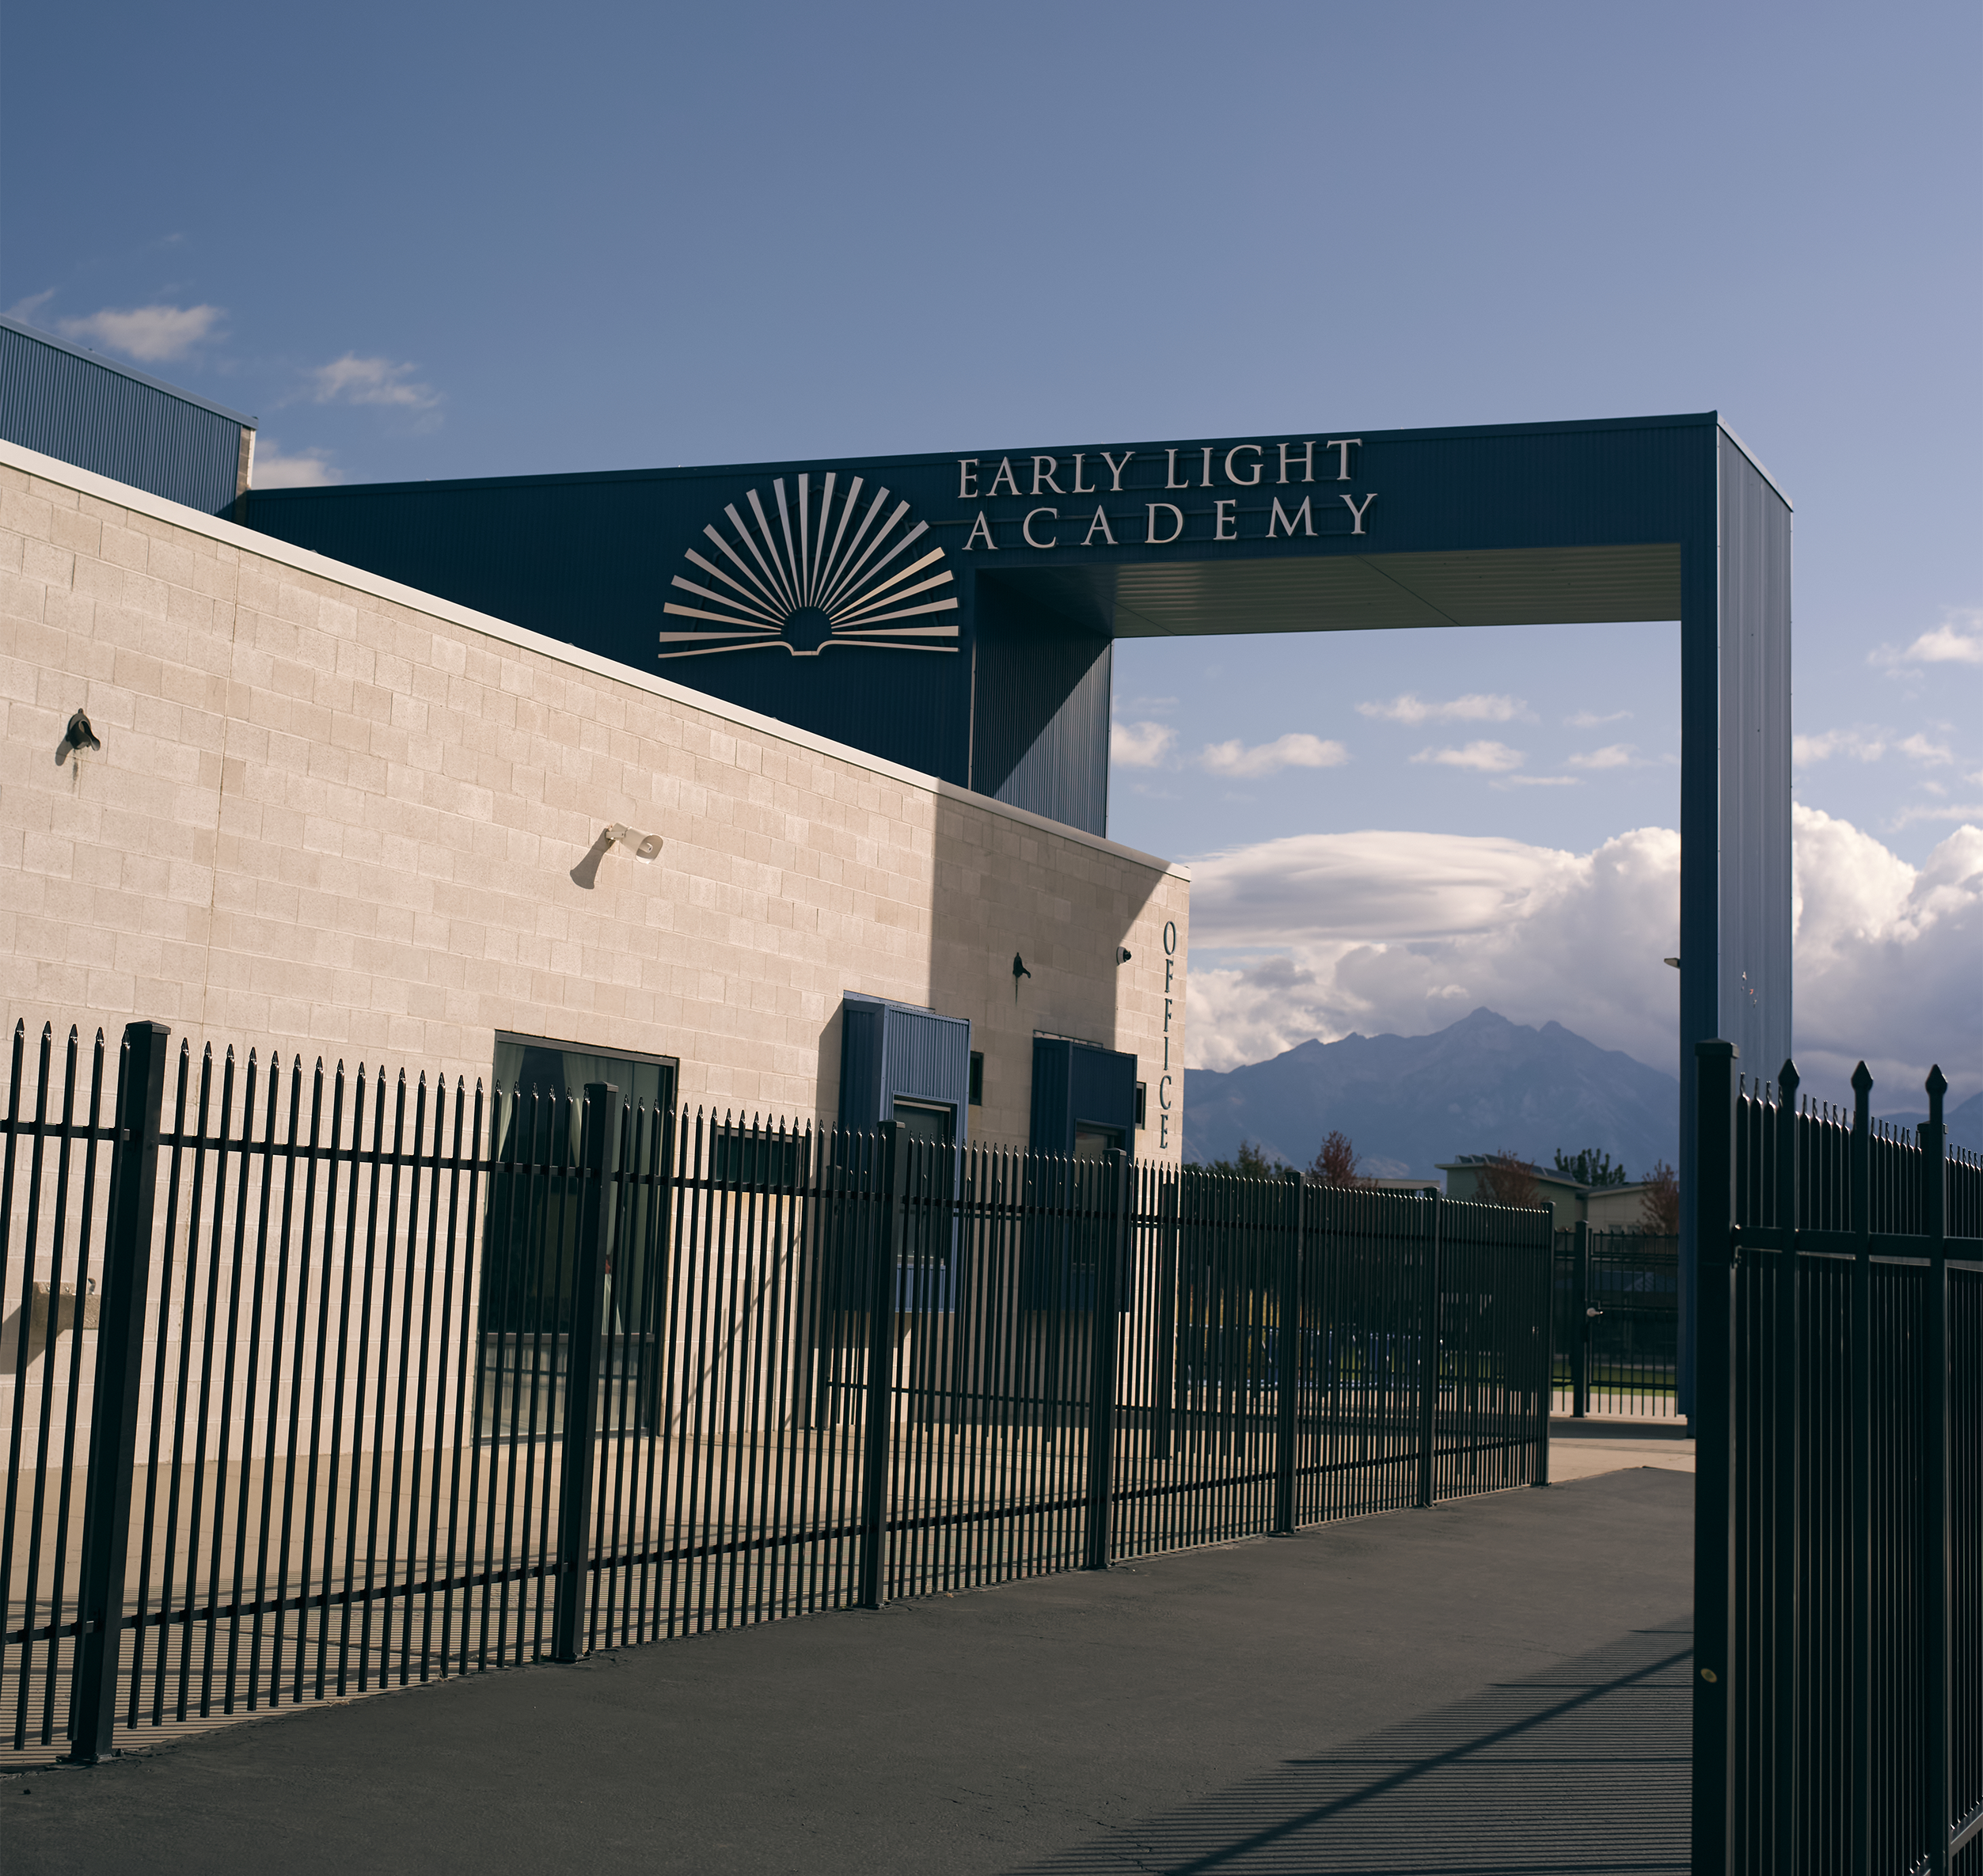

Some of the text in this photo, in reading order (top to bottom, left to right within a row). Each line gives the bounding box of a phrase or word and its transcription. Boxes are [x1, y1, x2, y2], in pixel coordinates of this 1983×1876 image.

[957, 438, 1363, 499] EARLY LIGHT
[961, 492, 1378, 551] ACADEMY
[1159, 920, 1177, 1149] OFFICE
